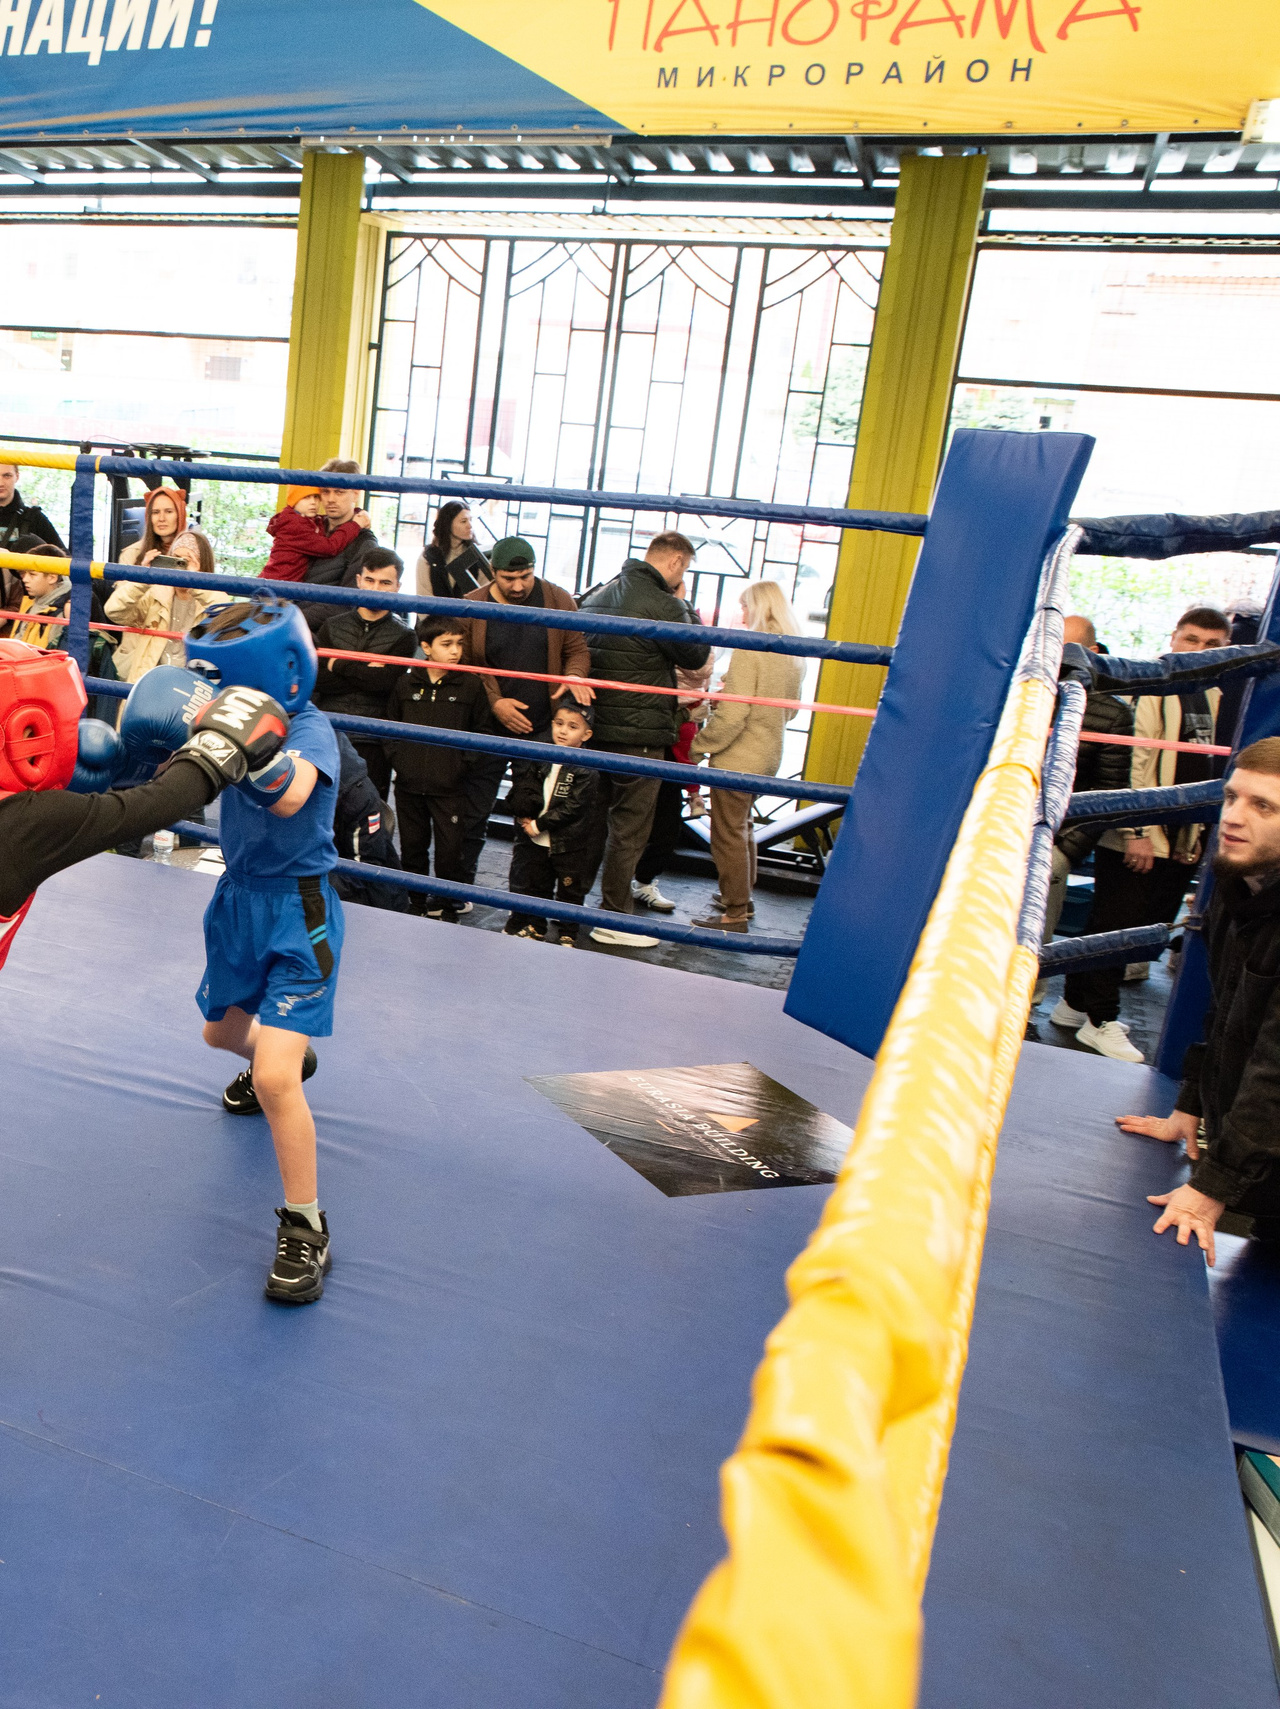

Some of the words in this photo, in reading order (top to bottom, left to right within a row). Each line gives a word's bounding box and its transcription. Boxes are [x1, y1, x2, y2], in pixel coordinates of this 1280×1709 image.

[607, 0, 1140, 53] ПАНОРАМА
[657, 55, 1035, 88] МИКРОРАЙОН
[627, 1076, 696, 1121] EURASIA
[693, 1122, 780, 1179] BUILDING
